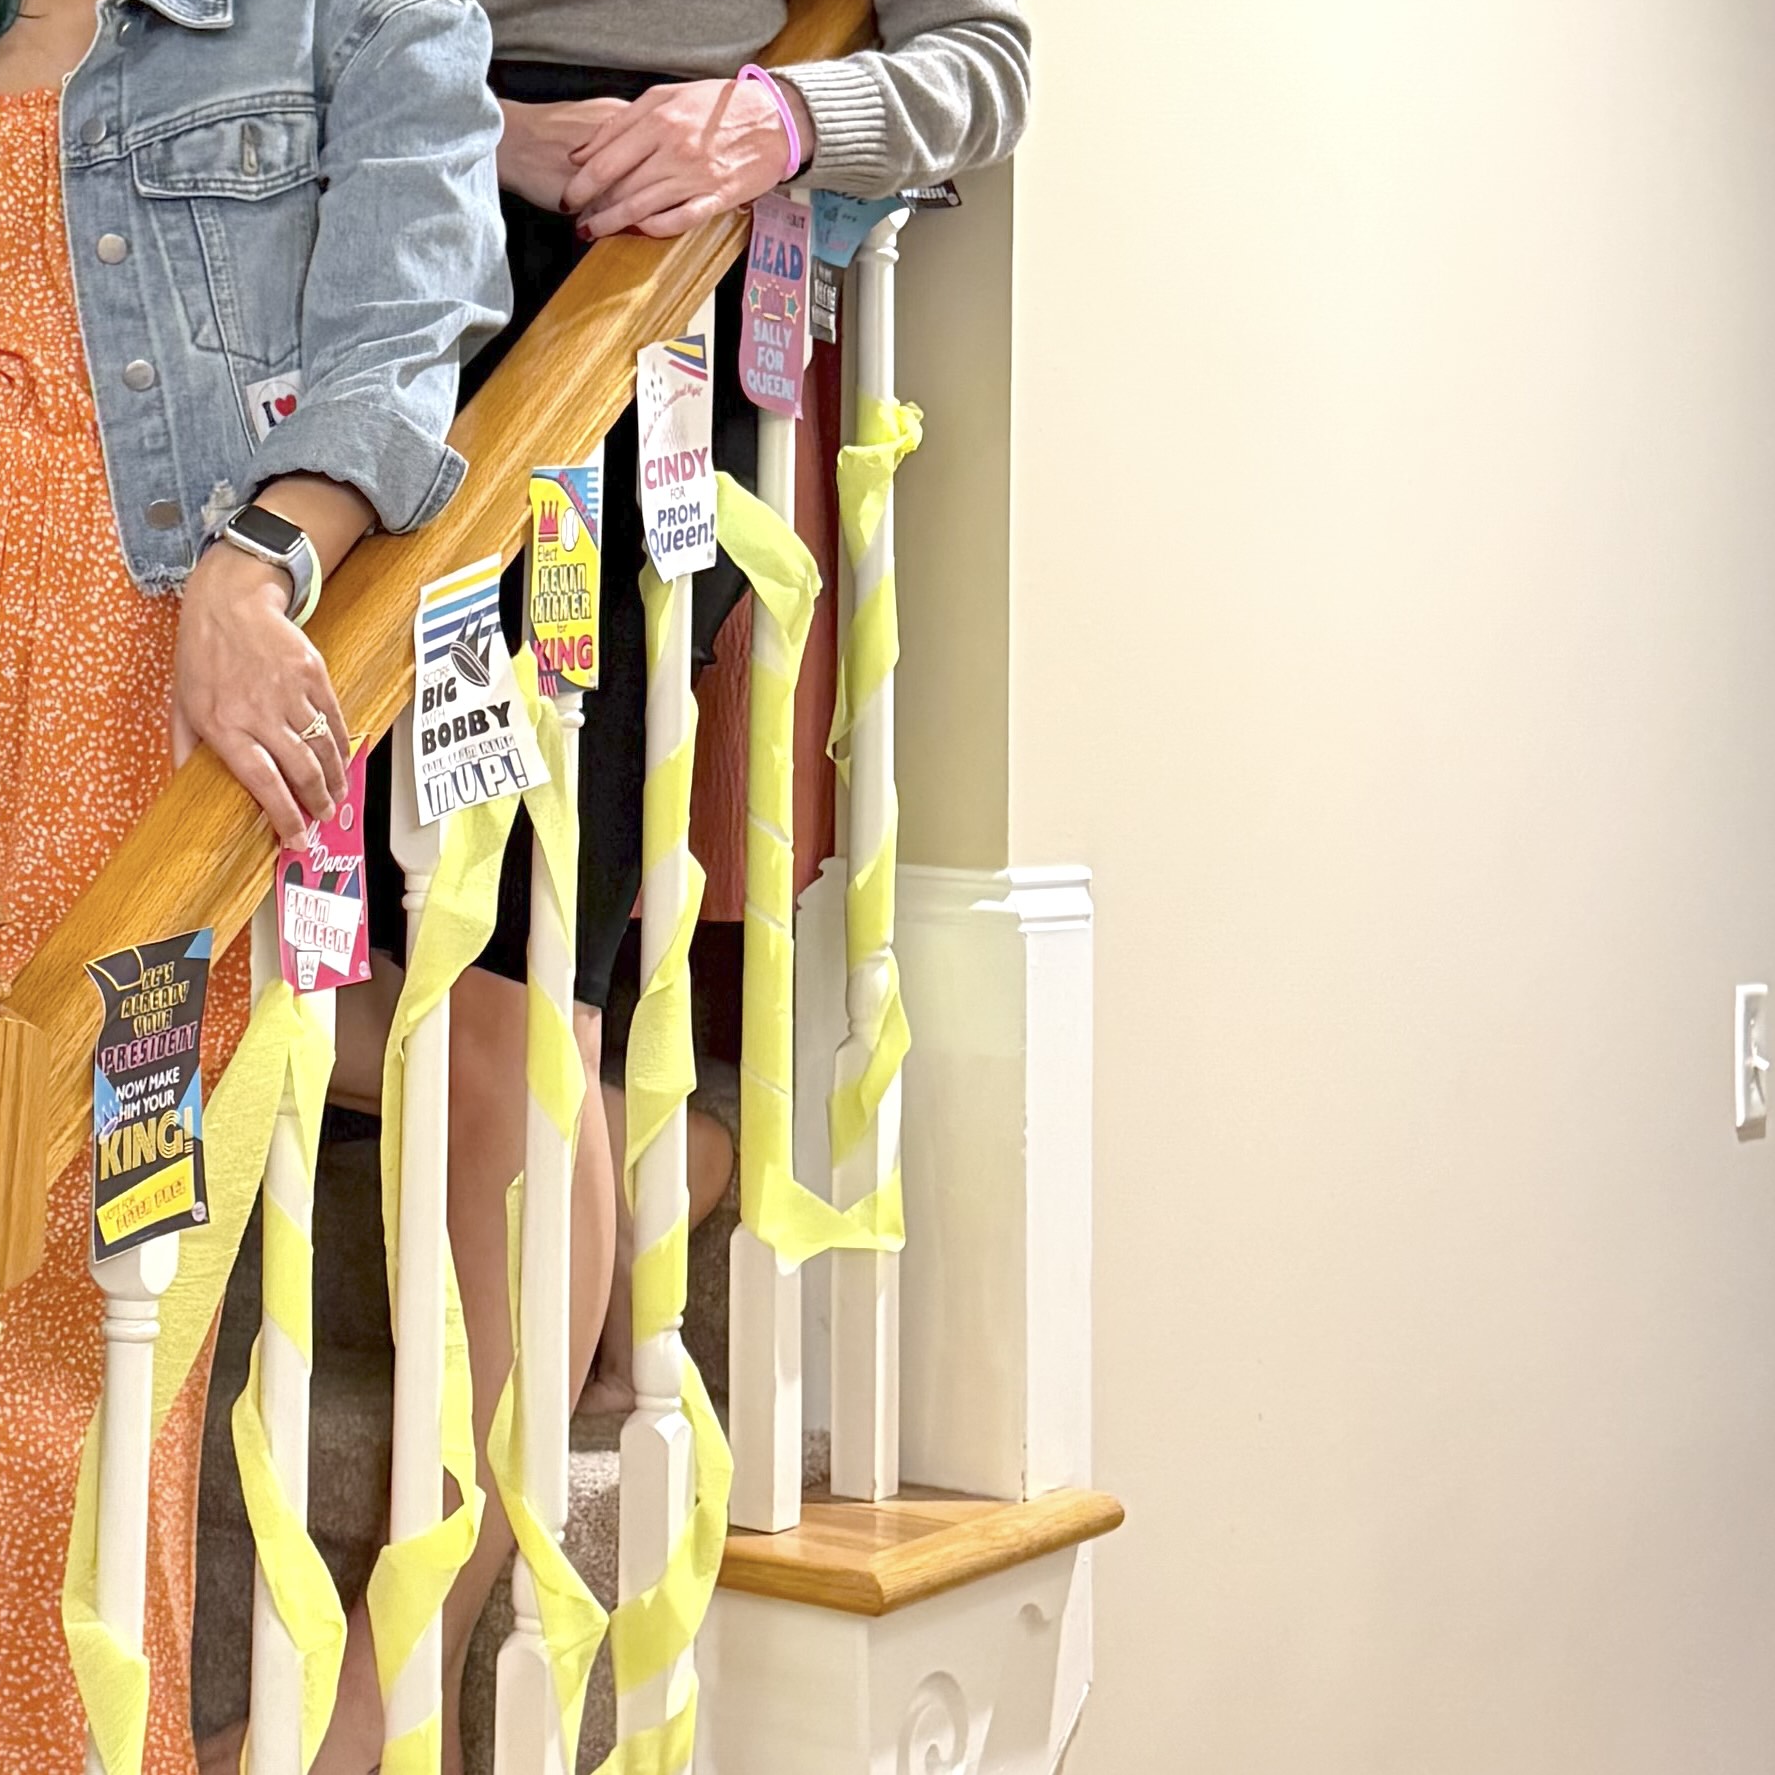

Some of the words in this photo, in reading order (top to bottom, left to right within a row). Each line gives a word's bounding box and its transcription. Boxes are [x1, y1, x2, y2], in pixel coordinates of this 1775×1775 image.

[750, 230, 804, 281] LEAD
[752, 319, 792, 350] SALLY
[757, 346, 784, 373] FOR
[262, 400, 277, 428] I
[644, 447, 708, 490] CINDY
[670, 485, 686, 500] FOR
[657, 502, 701, 529] PROM
[537, 545, 558, 563] Elect
[649, 513, 715, 562] Queen!
[539, 563, 587, 595] KEVIN
[533, 591, 592, 624] KICKER
[534, 634, 593, 672] KING
[422, 676, 458, 715] BIG
[421, 700, 511, 756] BOBBY
[425, 748, 530, 818] MVP!
[312, 845, 363, 872] Dancer
[287, 889, 331, 923] PROM
[294, 918, 352, 954] QUEEN!
[142, 961, 175, 990] HE'S
[121, 980, 190, 1019] ALREADY
[133, 1008, 173, 1039] YOUR
[100, 1021, 198, 1076] PRESIDENT
[115, 1076, 148, 1102] NOW
[148, 1066, 180, 1092] MAKE
[118, 1100, 140, 1123] HIM
[143, 1089, 176, 1114] YOUR
[98, 1106, 194, 1181] KING!
